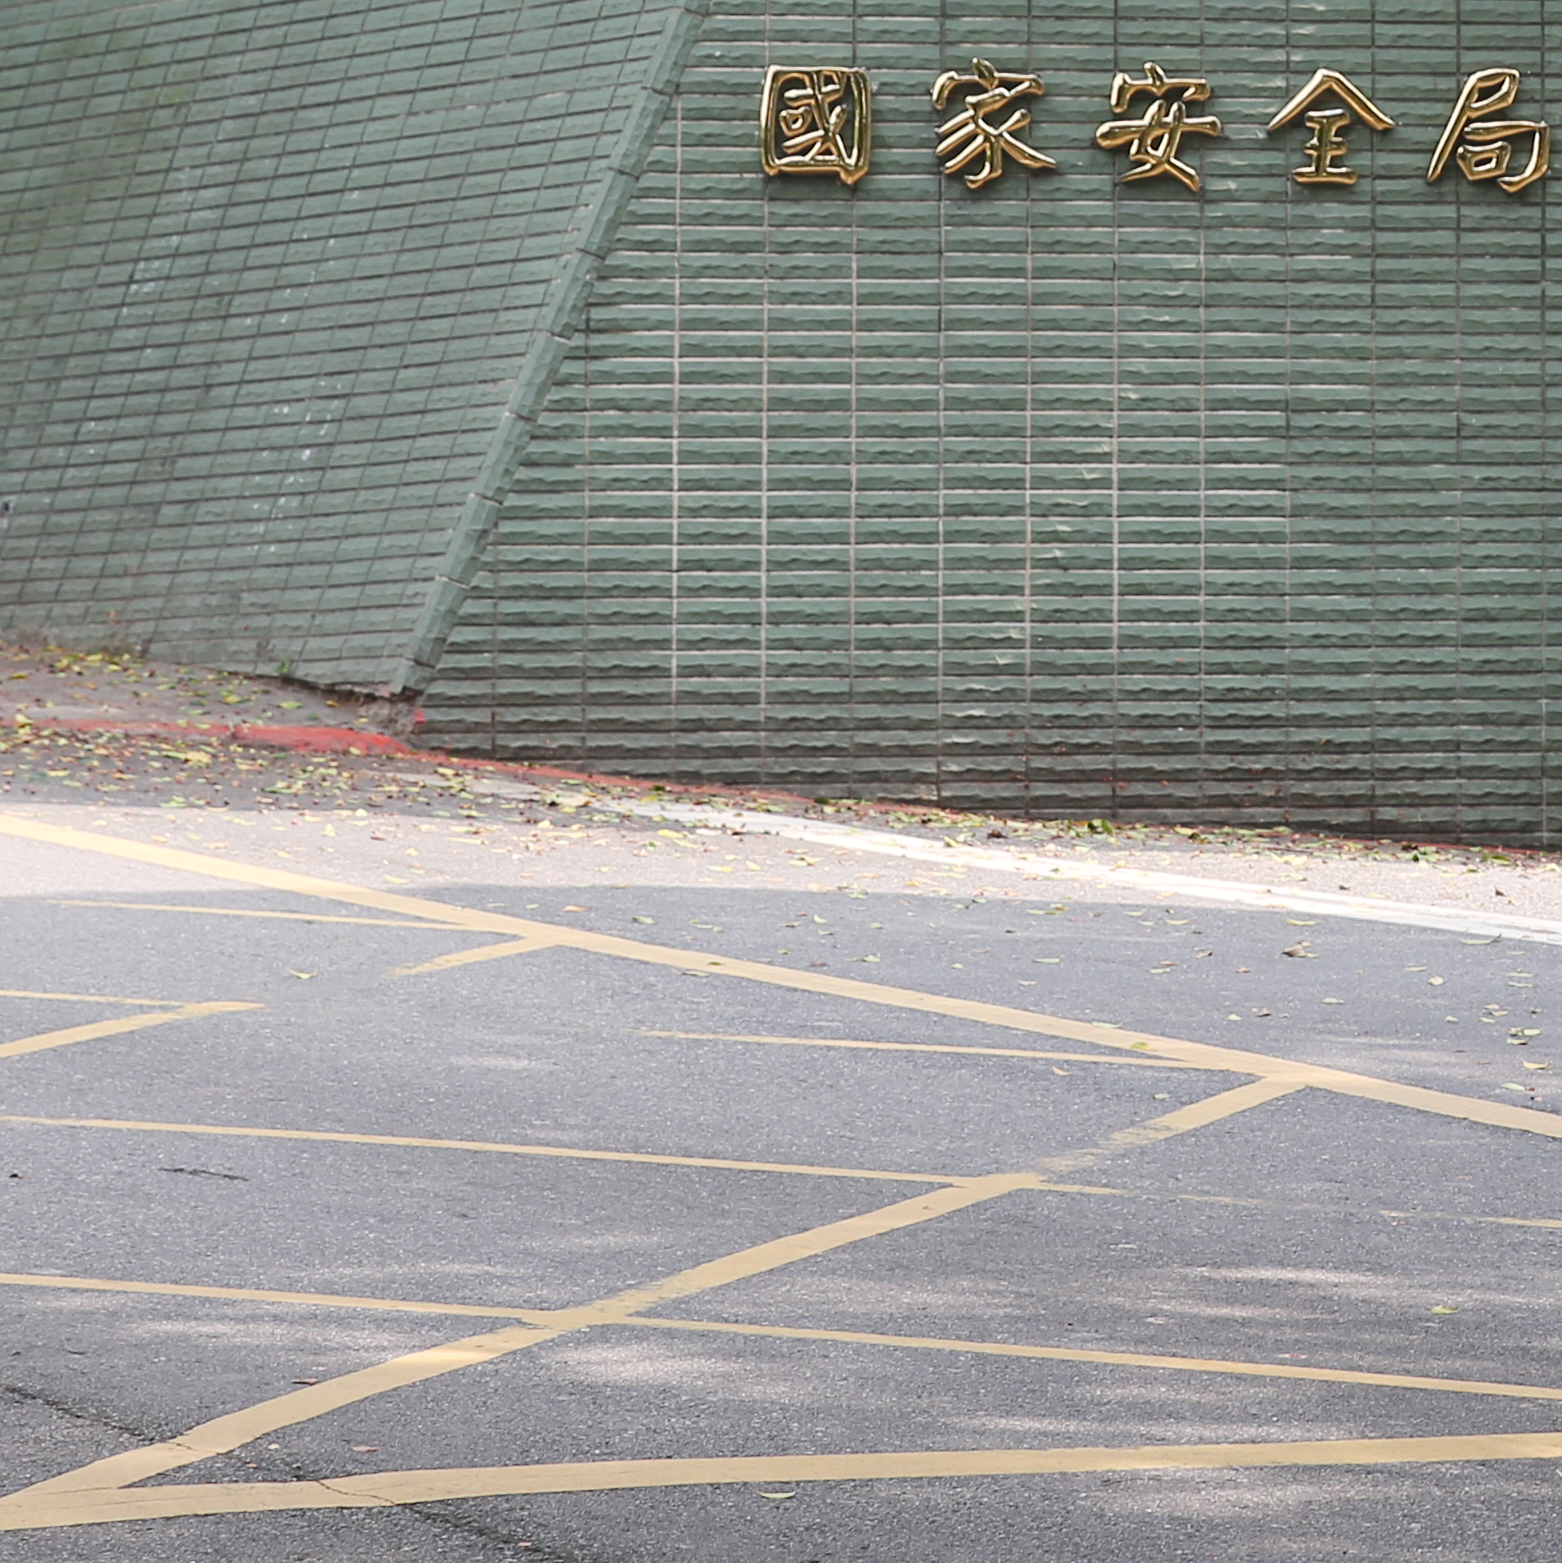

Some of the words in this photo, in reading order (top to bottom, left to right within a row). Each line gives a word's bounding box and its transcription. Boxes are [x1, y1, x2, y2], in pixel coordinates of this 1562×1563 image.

[761, 57, 1550, 192] 國家安全局
